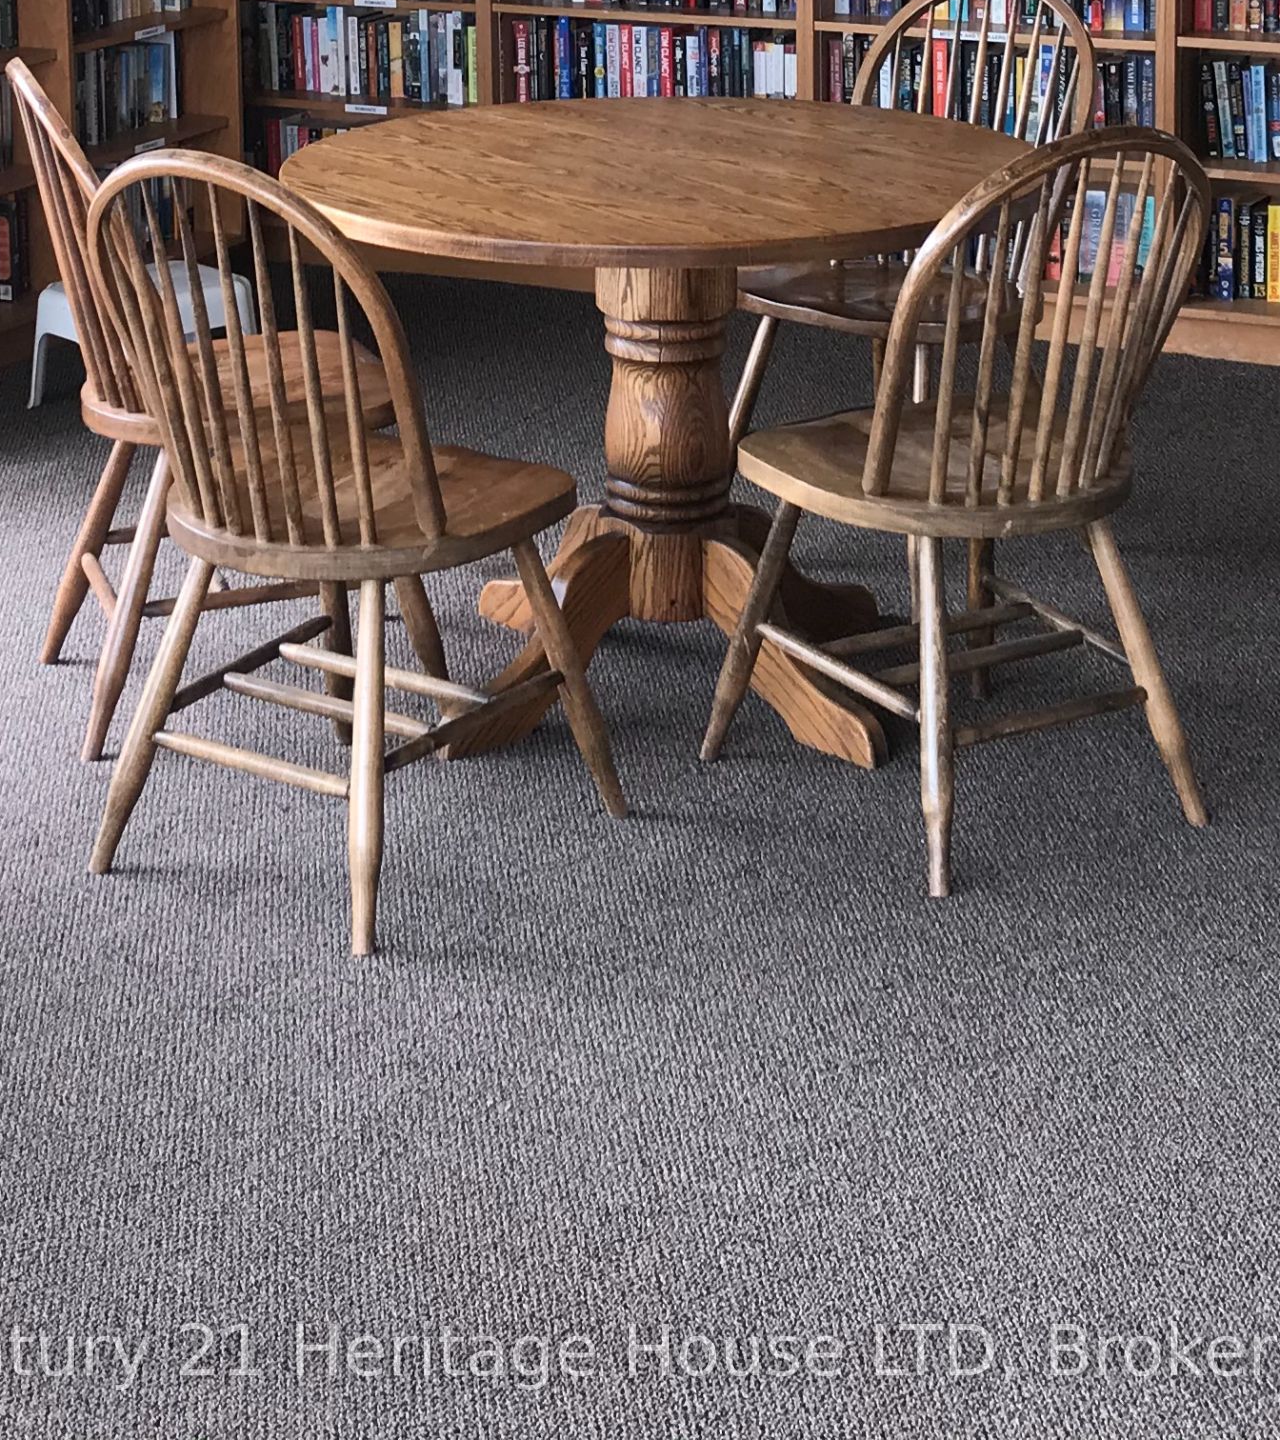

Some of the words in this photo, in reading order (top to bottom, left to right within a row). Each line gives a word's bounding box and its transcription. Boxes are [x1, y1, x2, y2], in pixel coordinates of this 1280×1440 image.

[621, 29, 629, 42] TOM
[634, 30, 643, 44] TOM
[661, 32, 670, 47] TOM
[621, 44, 629, 70] CLANCY
[634, 47, 643, 75] CLANCY
[661, 49, 670, 78] CLANCY
